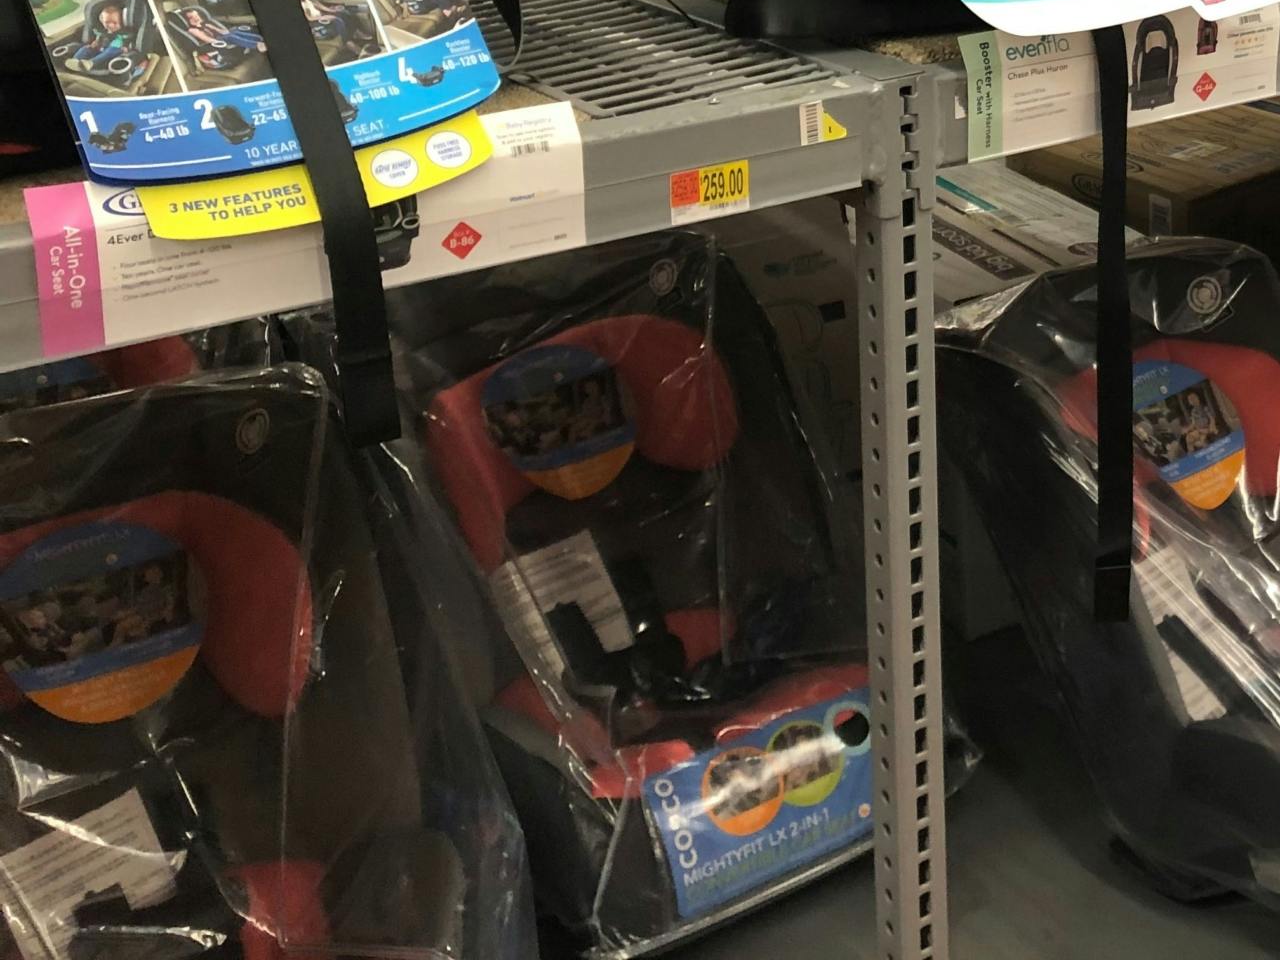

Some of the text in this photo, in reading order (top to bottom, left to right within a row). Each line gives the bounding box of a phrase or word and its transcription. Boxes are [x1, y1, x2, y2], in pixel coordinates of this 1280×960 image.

[479, 52, 490, 63] lb
[1005, 34, 1070, 61] evenflo
[398, 56, 418, 84] 4
[979, 41, 993, 89] Booster
[389, 85, 400, 96] lb
[976, 78, 984, 115] Car Seat
[79, 110, 99, 134] 1
[193, 98, 216, 130] 2
[352, 119, 385, 137] SEAT
[178, 124, 190, 137] lb
[244, 141, 299, 159] 10 YEAR
[169, 183, 302, 214] 3 NEW FEATURES
[703, 167, 744, 202] 259.00
[209, 196, 307, 222] TO HELP YOU
[107, 231, 144, 246] 4Ever
[49, 245, 65, 296] Car Seat
[62, 224, 87, 310] All-in-One
[655, 778, 698, 870] COCO
[683, 836, 764, 888] MIGHTYFIT
[769, 829, 787, 846] LX
